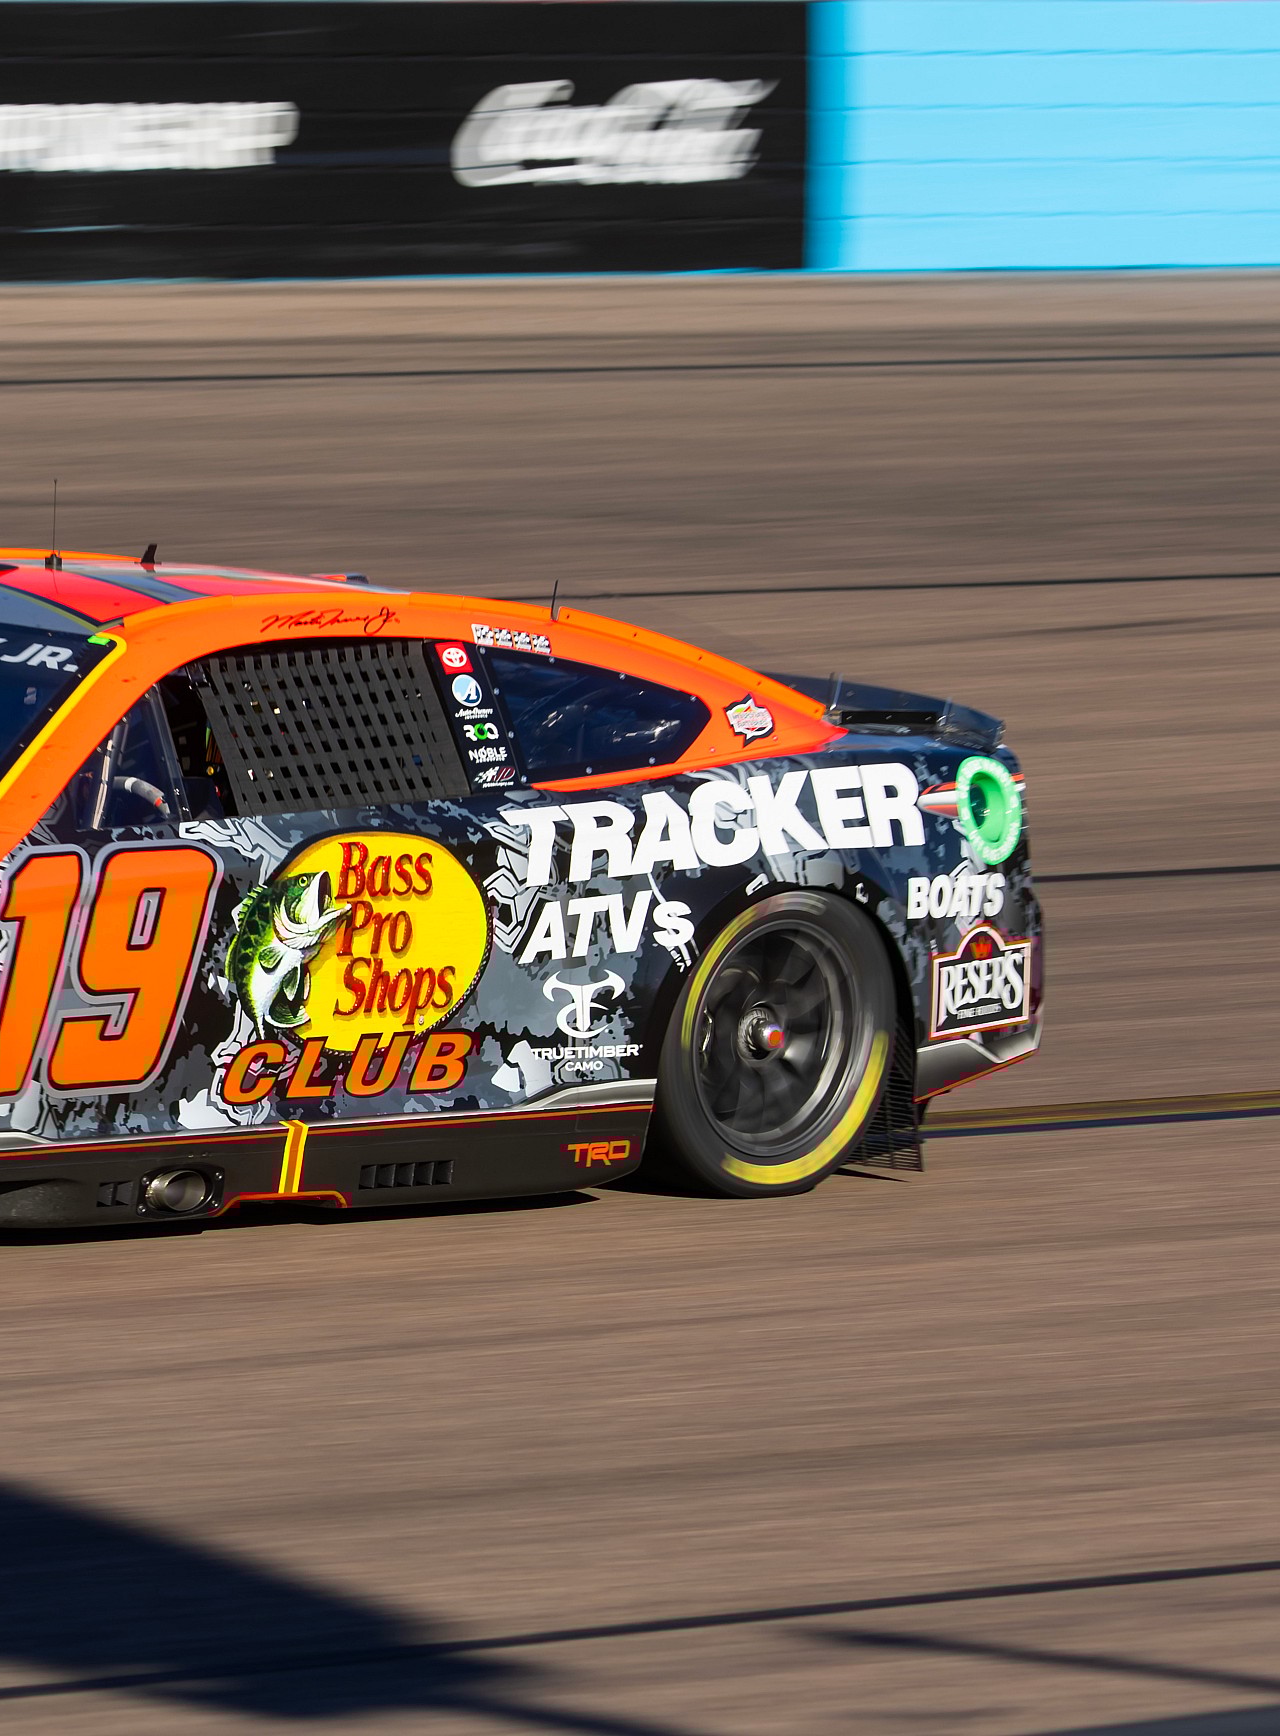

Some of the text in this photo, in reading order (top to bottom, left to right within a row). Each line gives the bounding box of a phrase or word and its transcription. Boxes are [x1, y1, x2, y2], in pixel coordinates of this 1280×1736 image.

[0, 643, 80, 673] JR.
[498, 762, 926, 887] TRACKER
[335, 841, 434, 900] Bass
[907, 872, 1006, 920] BOATS
[336, 901, 413, 957] Pro
[333, 957, 456, 1026] Shops
[222, 1031, 476, 1105] CLUB
[531, 1044, 641, 1061] TRUETIMBER
[565, 1061, 604, 1072] CAMO
[567, 1140, 631, 1168] TRD
